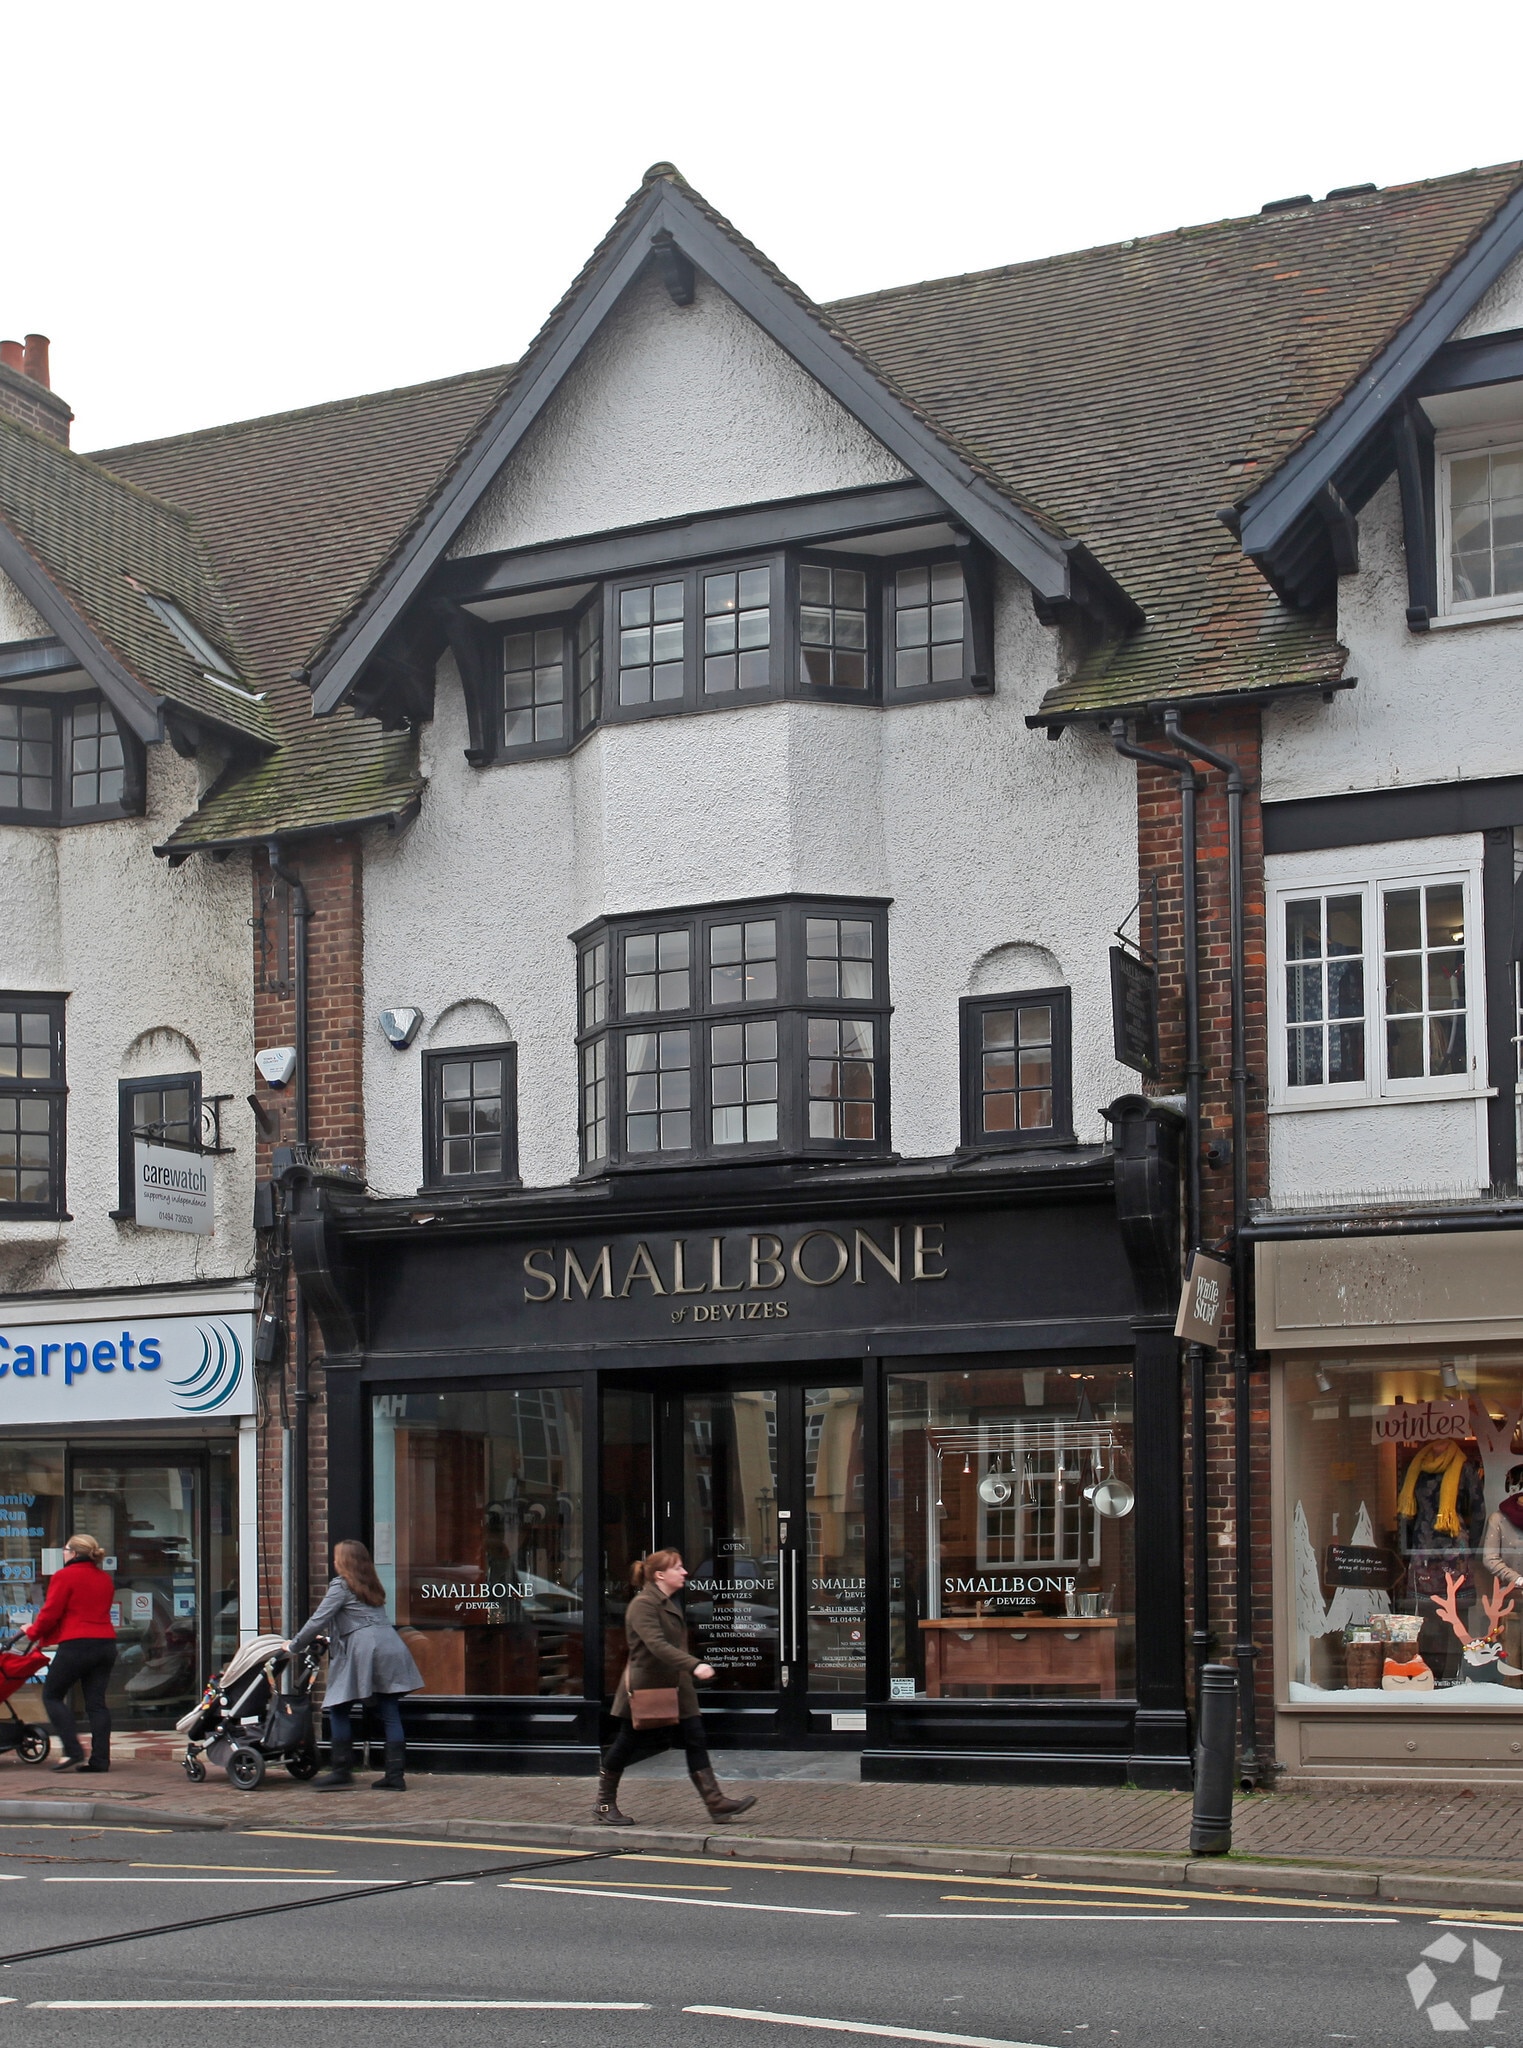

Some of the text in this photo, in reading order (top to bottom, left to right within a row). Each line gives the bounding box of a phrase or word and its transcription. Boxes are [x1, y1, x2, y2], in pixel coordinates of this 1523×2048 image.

[143, 1164, 206, 1192] carewatch
[144, 1192, 207, 1208] supporting independence
[158, 1212, 174, 1221] 01494
[523, 1222, 949, 1303] SMALLBONE
[670, 1301, 790, 1325] of DEVIZES
[722, 1543, 746, 1551] OPEN
[421, 1582, 534, 1599] SMALLBONE
[689, 1578, 775, 1591] SMALLBONE
[944, 1576, 1077, 1594] SMALLBONE
[721, 1592, 752, 1600] DEVIZES
[836, 1592, 842, 1600] of
[984, 1596, 1036, 1608] of DEVIZES
[454, 1602, 500, 1612] of DEVIZES
